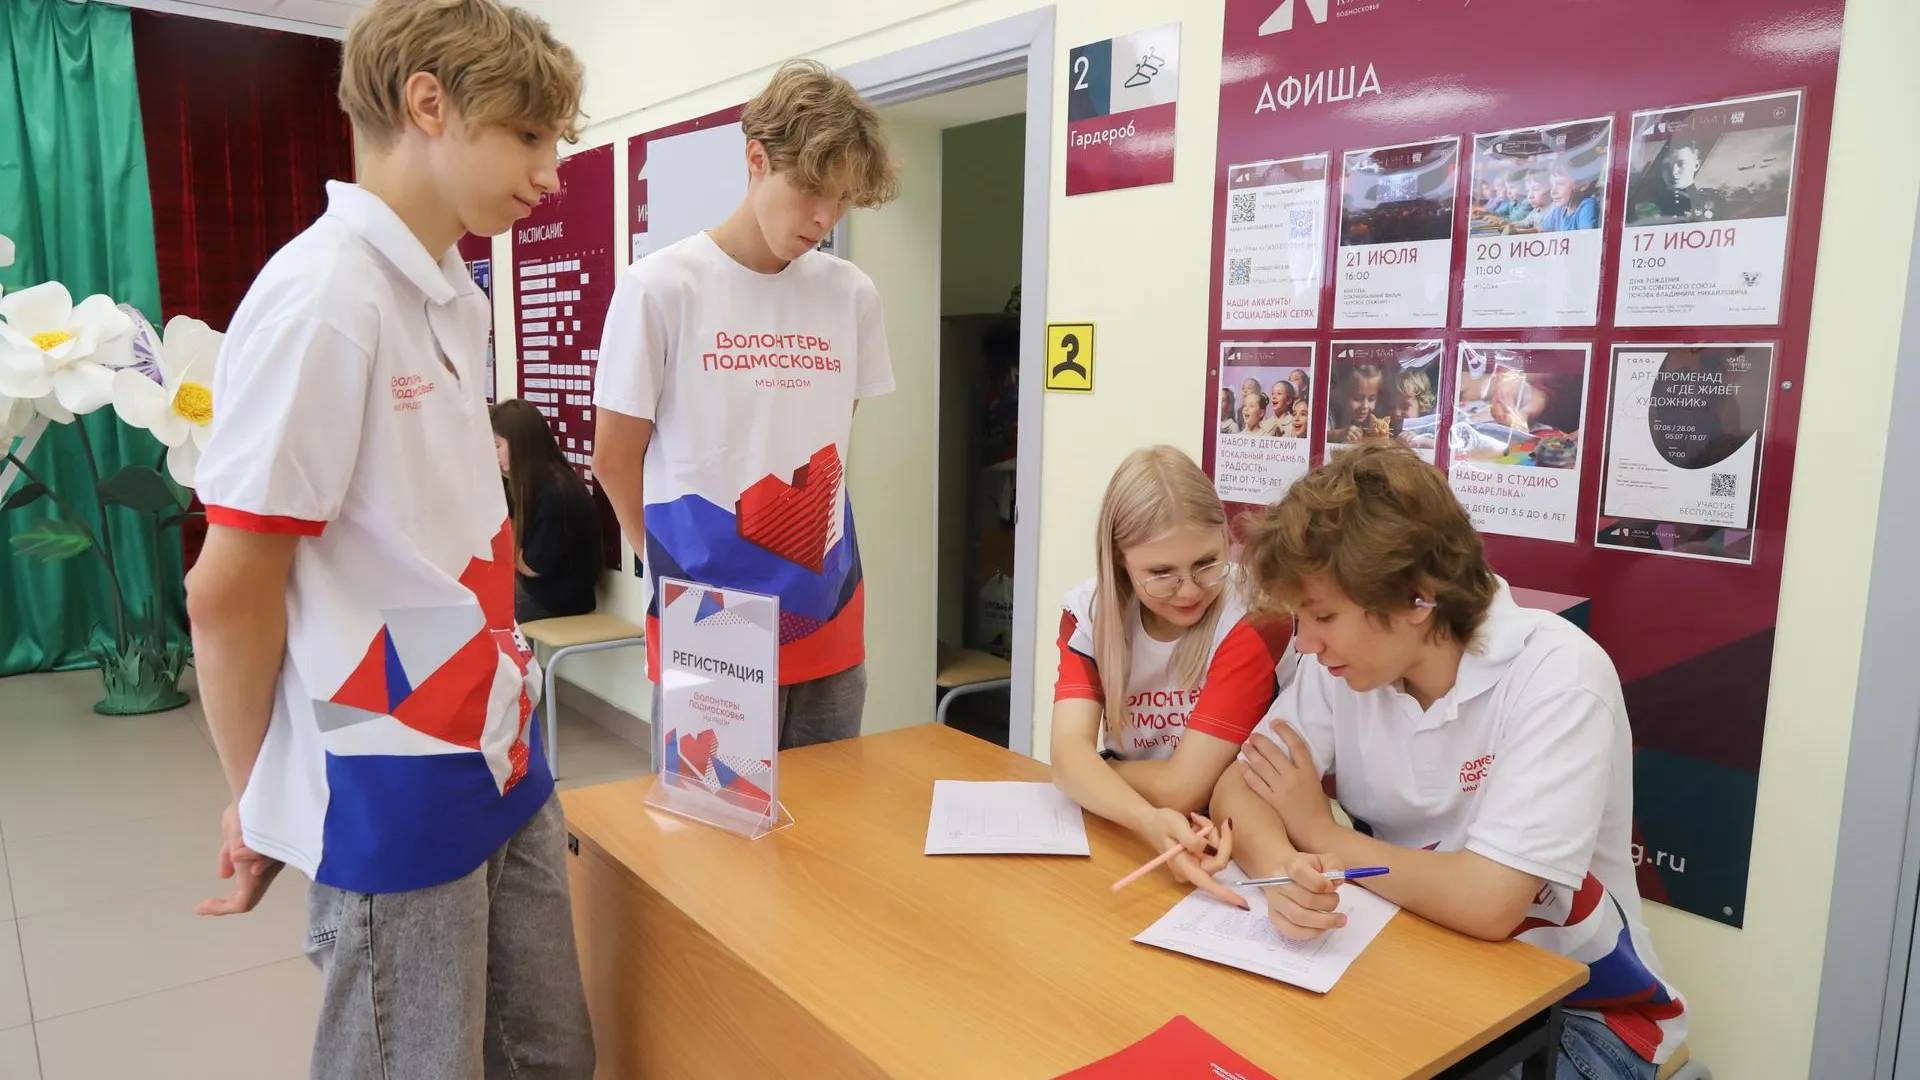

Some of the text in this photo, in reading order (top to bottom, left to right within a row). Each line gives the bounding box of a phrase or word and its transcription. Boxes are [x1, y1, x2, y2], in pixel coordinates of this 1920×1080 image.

[1074, 56, 1089, 91] 2
[1254, 62, 1382, 114] АФИША
[1071, 120, 1135, 150] Гардероб
[518, 221, 564, 244] РАСПИСАНИЕ
[1633, 228, 1736, 252] 17 ИЮЛЯ
[1477, 238, 1570, 260] 20 ИЮЛЯ
[1346, 247, 1418, 267] 21 ИЮЛЯ
[1632, 257, 1666, 268] 12:00
[1346, 271, 1369, 280] 16:00
[1476, 265, 1501, 275] 11:00
[1226, 297, 1291, 307] НАШИ АККАУНТЫ
[1226, 309, 1315, 320] В СОЦИАЛЬНЫХ СЕТЯХ
[1631, 372, 1722, 383] АРТ-ПРОМЕНАД
[1667, 385, 1694, 395] «ГДЕ
[1636, 397, 1707, 407] ХУДОЖНИК»
[1221, 437, 1297, 450] НАБОР В ДЕТСКИЙ
[1221, 450, 1306, 463] ВОКАЛЬНЫЙ АНСАМБЛЬ
[1220, 474, 1238, 482] ДЕТИ
[1269, 479, 1282, 487] ЛЕТ
[1455, 470, 1559, 488] НАБОР В СТУДИЮ
[1472, 504, 1495, 514] ДЕТЕЙ
[1497, 507, 1508, 515] ОТ
[1526, 510, 1540, 519] ДО
[1542, 511, 1548, 519] 6
[1551, 513, 1566, 521] ЛЕТ
[1697, 501, 1736, 511] УЧАСТИЕ
[1679, 508, 1735, 519] БЕСПЛАТНОЕ
[672, 650, 764, 684] РЕГИСТРАЦИЯ
